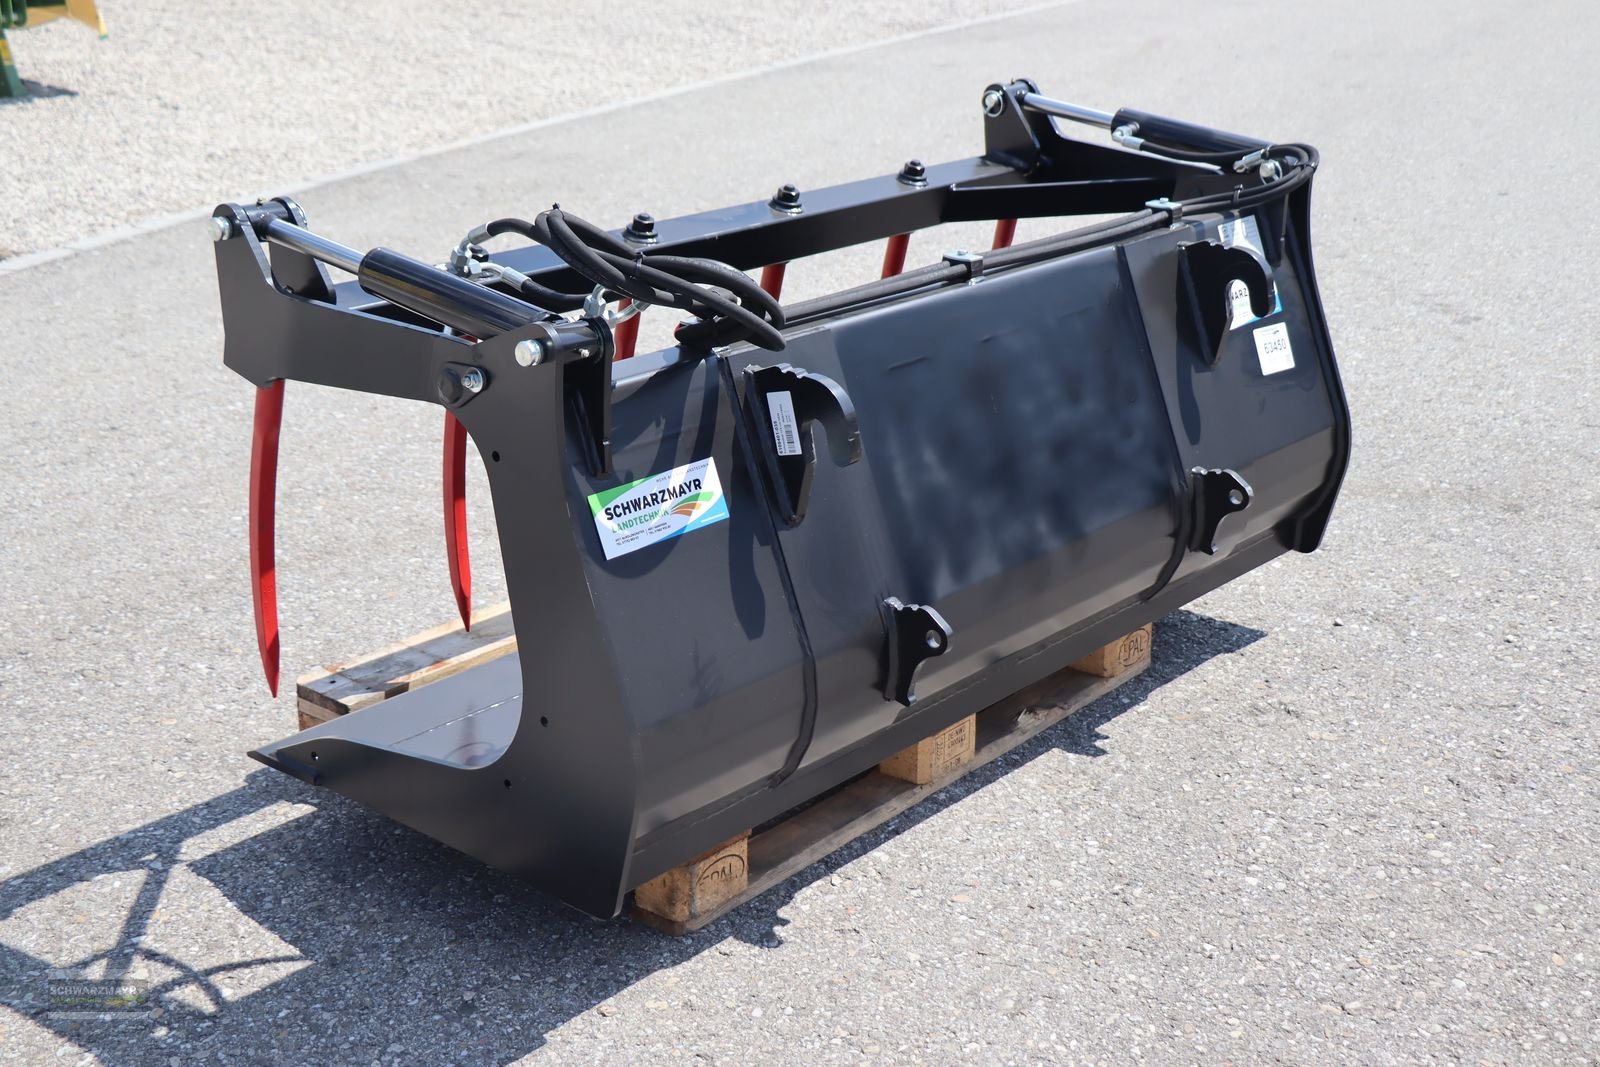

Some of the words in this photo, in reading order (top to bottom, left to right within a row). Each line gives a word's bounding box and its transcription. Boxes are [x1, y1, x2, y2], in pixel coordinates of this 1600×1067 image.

[1264, 338, 1287, 354] 63450
[604, 478, 702, 521] SCHWARZMAYR
[611, 508, 670, 534] LANDTECHNIK
